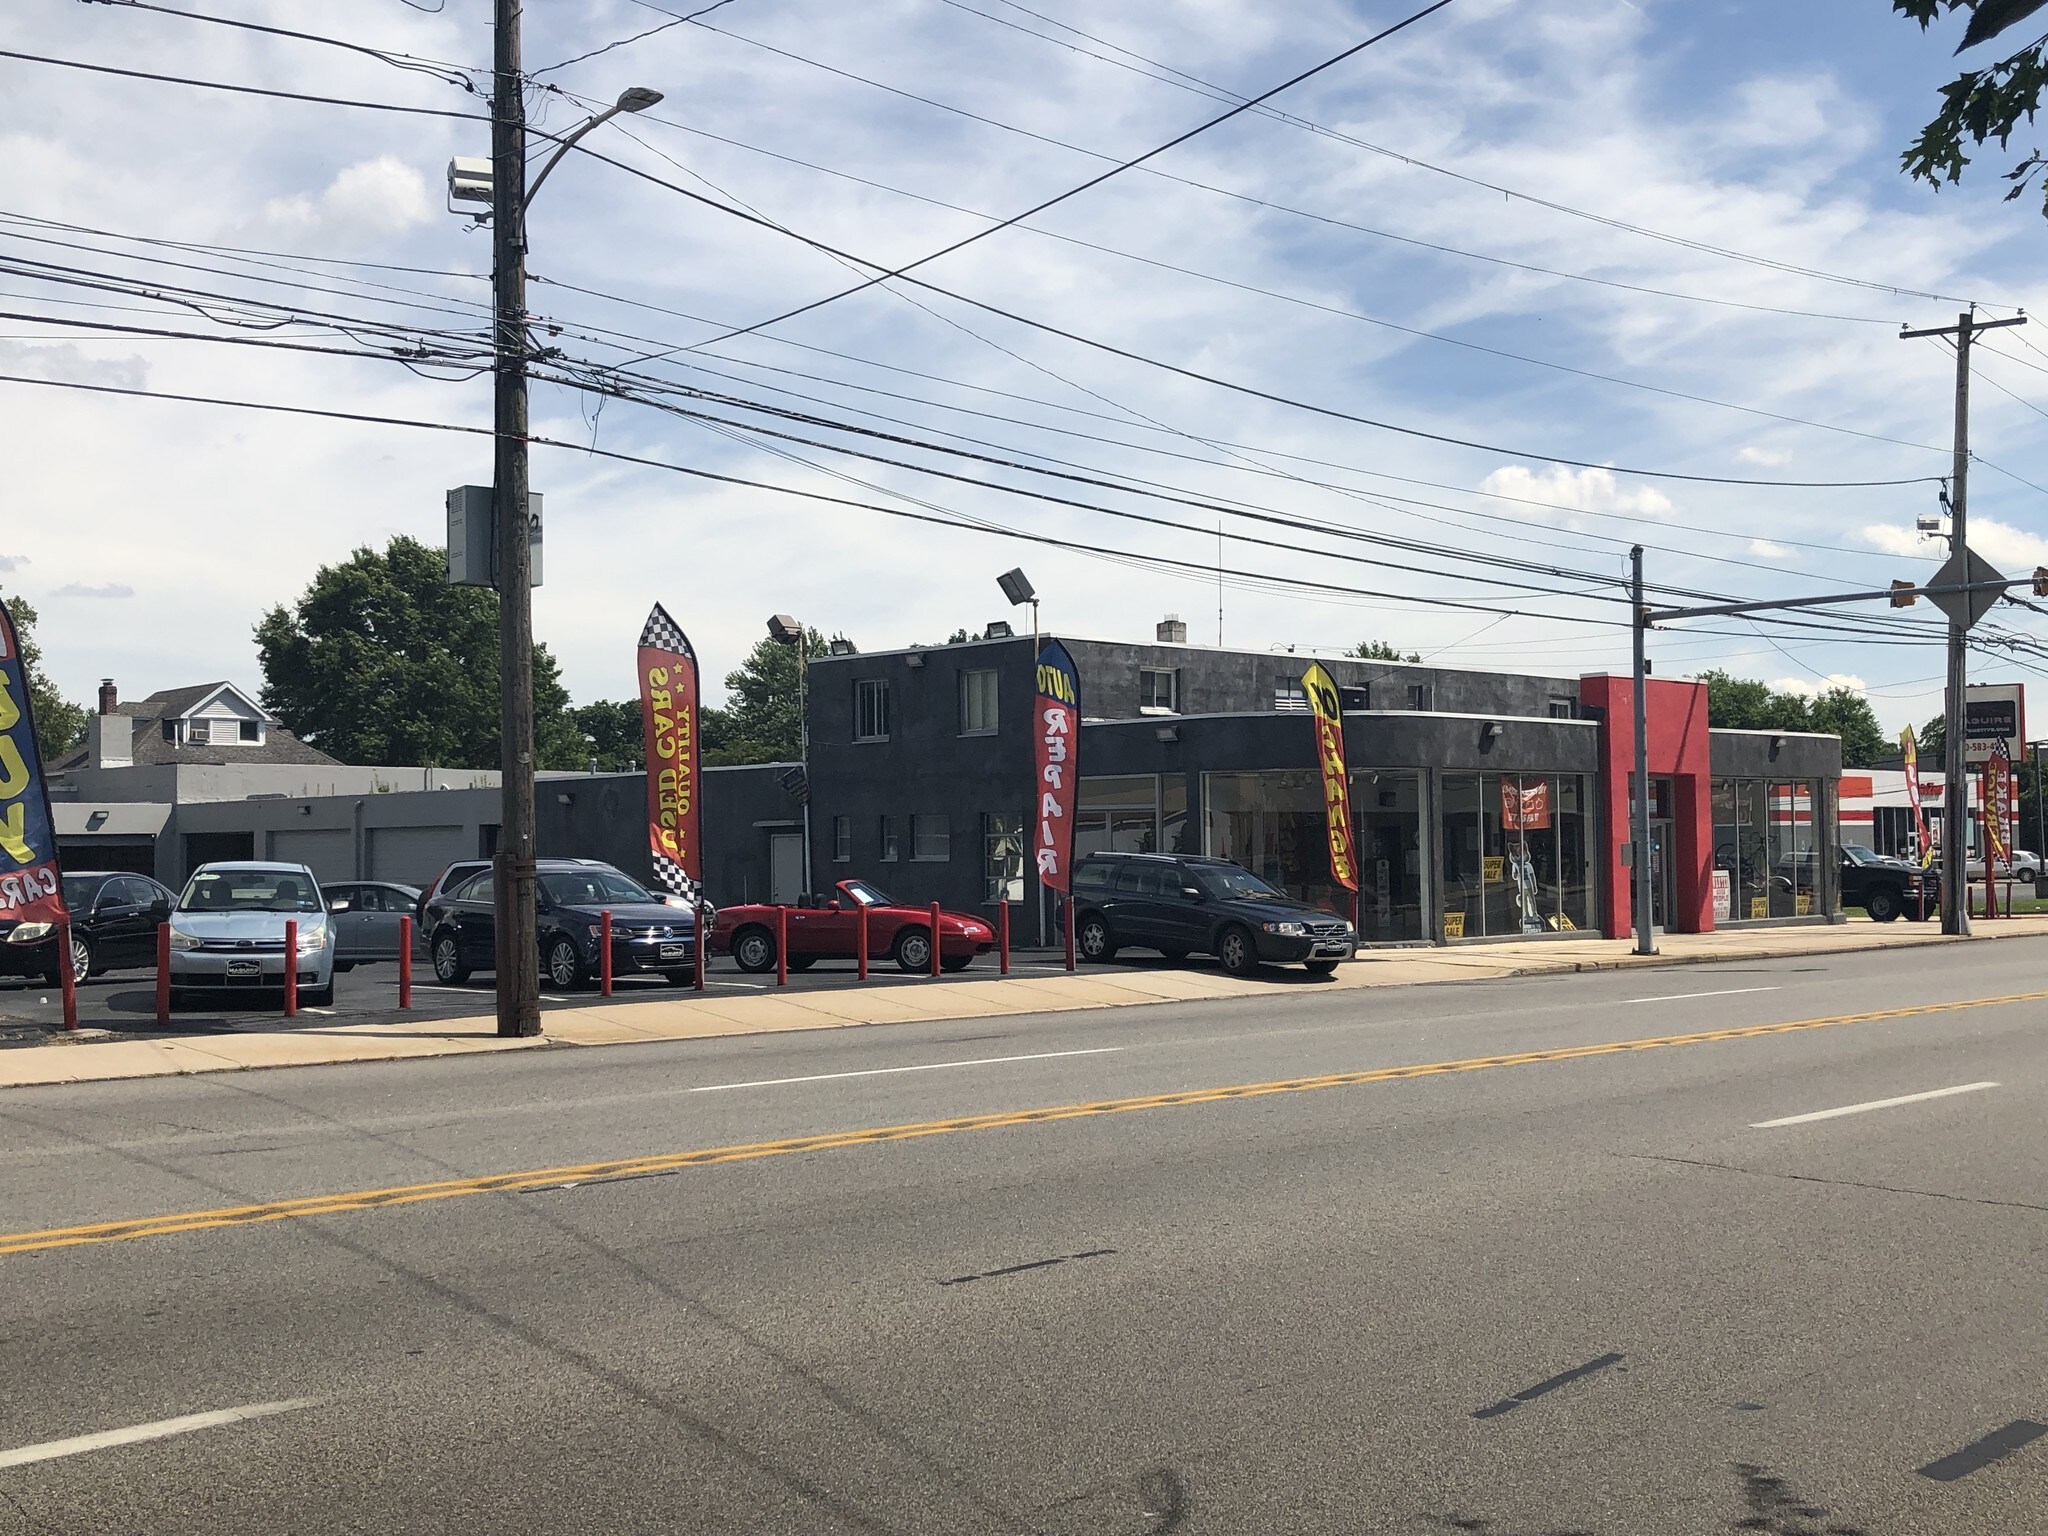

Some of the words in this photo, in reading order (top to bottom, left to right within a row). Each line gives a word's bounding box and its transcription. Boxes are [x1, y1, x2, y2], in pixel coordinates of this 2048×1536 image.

[1484, 860, 1502, 869] SUPER
[1444, 916, 1463, 926] SUPER
[1446, 927, 1460, 937] SALE
